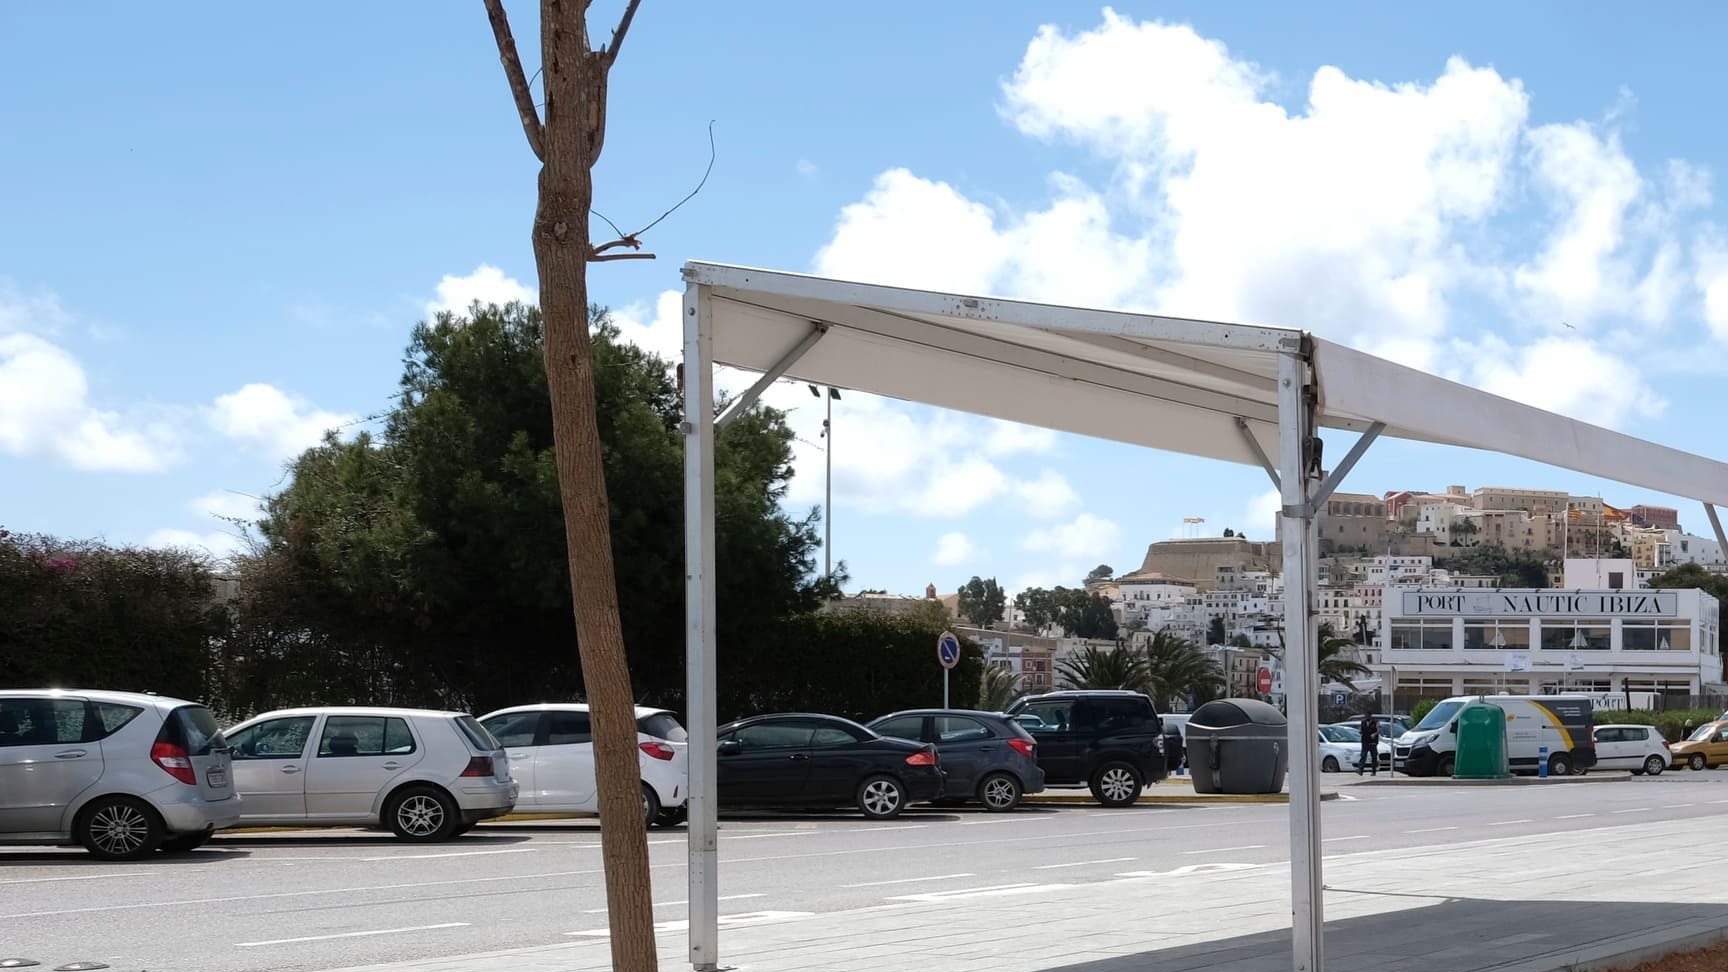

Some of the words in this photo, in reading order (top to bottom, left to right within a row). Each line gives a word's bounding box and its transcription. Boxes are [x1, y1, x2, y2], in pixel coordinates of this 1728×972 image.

[1417, 595, 1465, 613] PORT
[1503, 595, 1588, 613] NAUTIC
[1600, 595, 1662, 613] IBIZA
[1591, 698, 1624, 711] PORT
